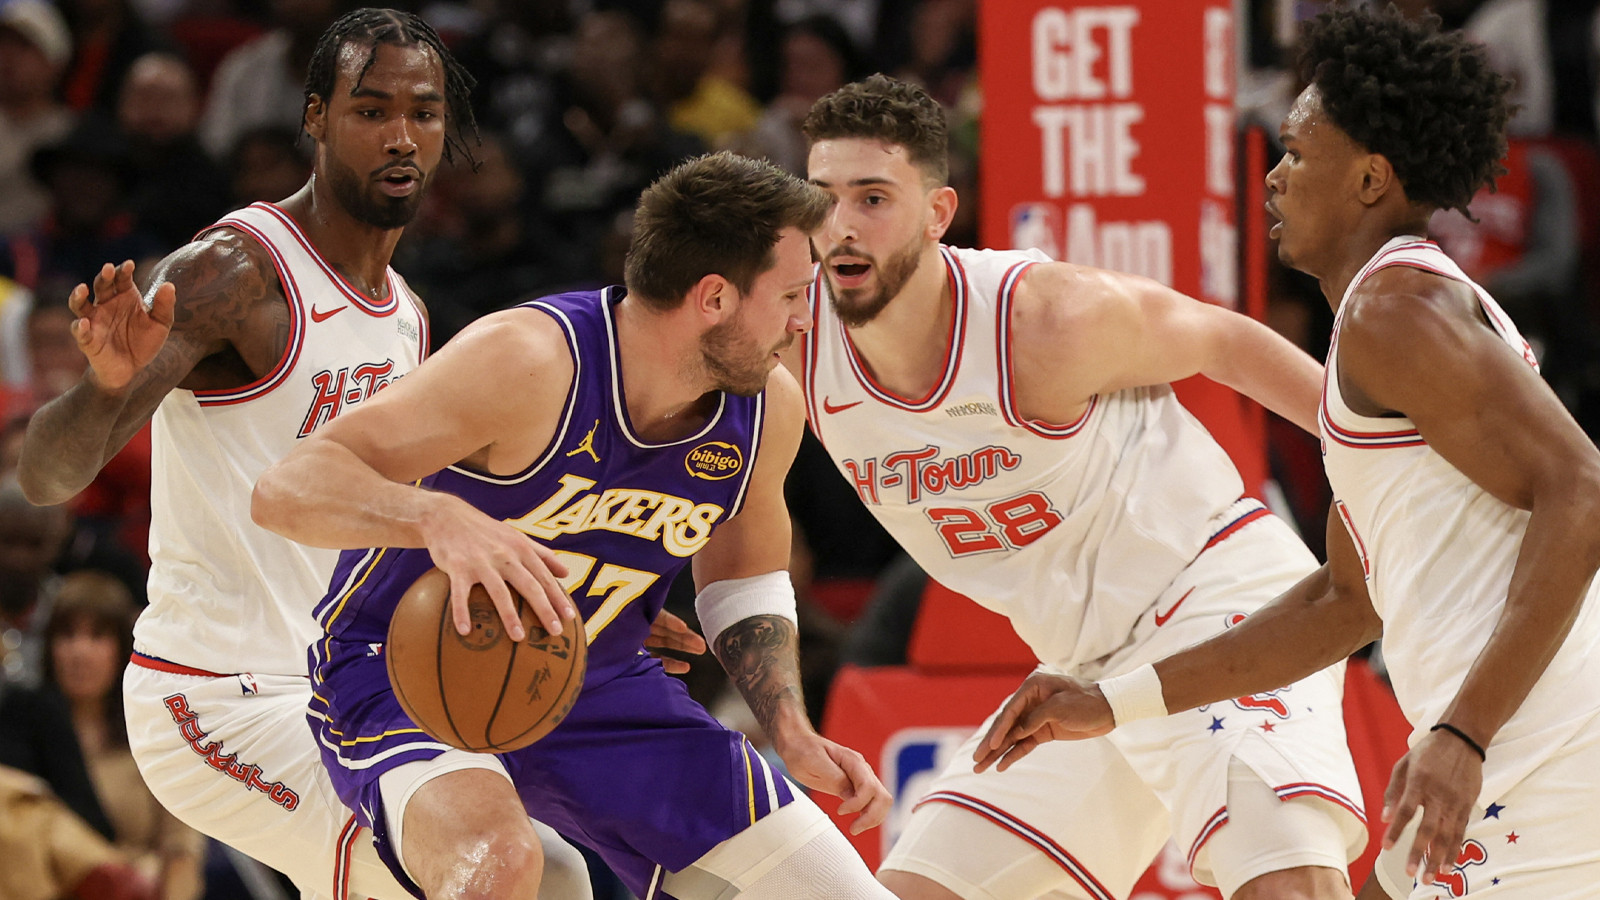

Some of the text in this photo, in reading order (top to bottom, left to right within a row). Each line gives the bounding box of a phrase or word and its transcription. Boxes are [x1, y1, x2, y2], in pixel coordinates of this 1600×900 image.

[1031, 7, 1141, 99] GET
[1032, 103, 1145, 197] THE
[691, 450, 739, 470] bibigo
[842, 445, 1021, 505] H-Town
[503, 473, 725, 558] LAKERS
[923, 491, 1065, 559] 28
[163, 692, 300, 812] ROCKETS
